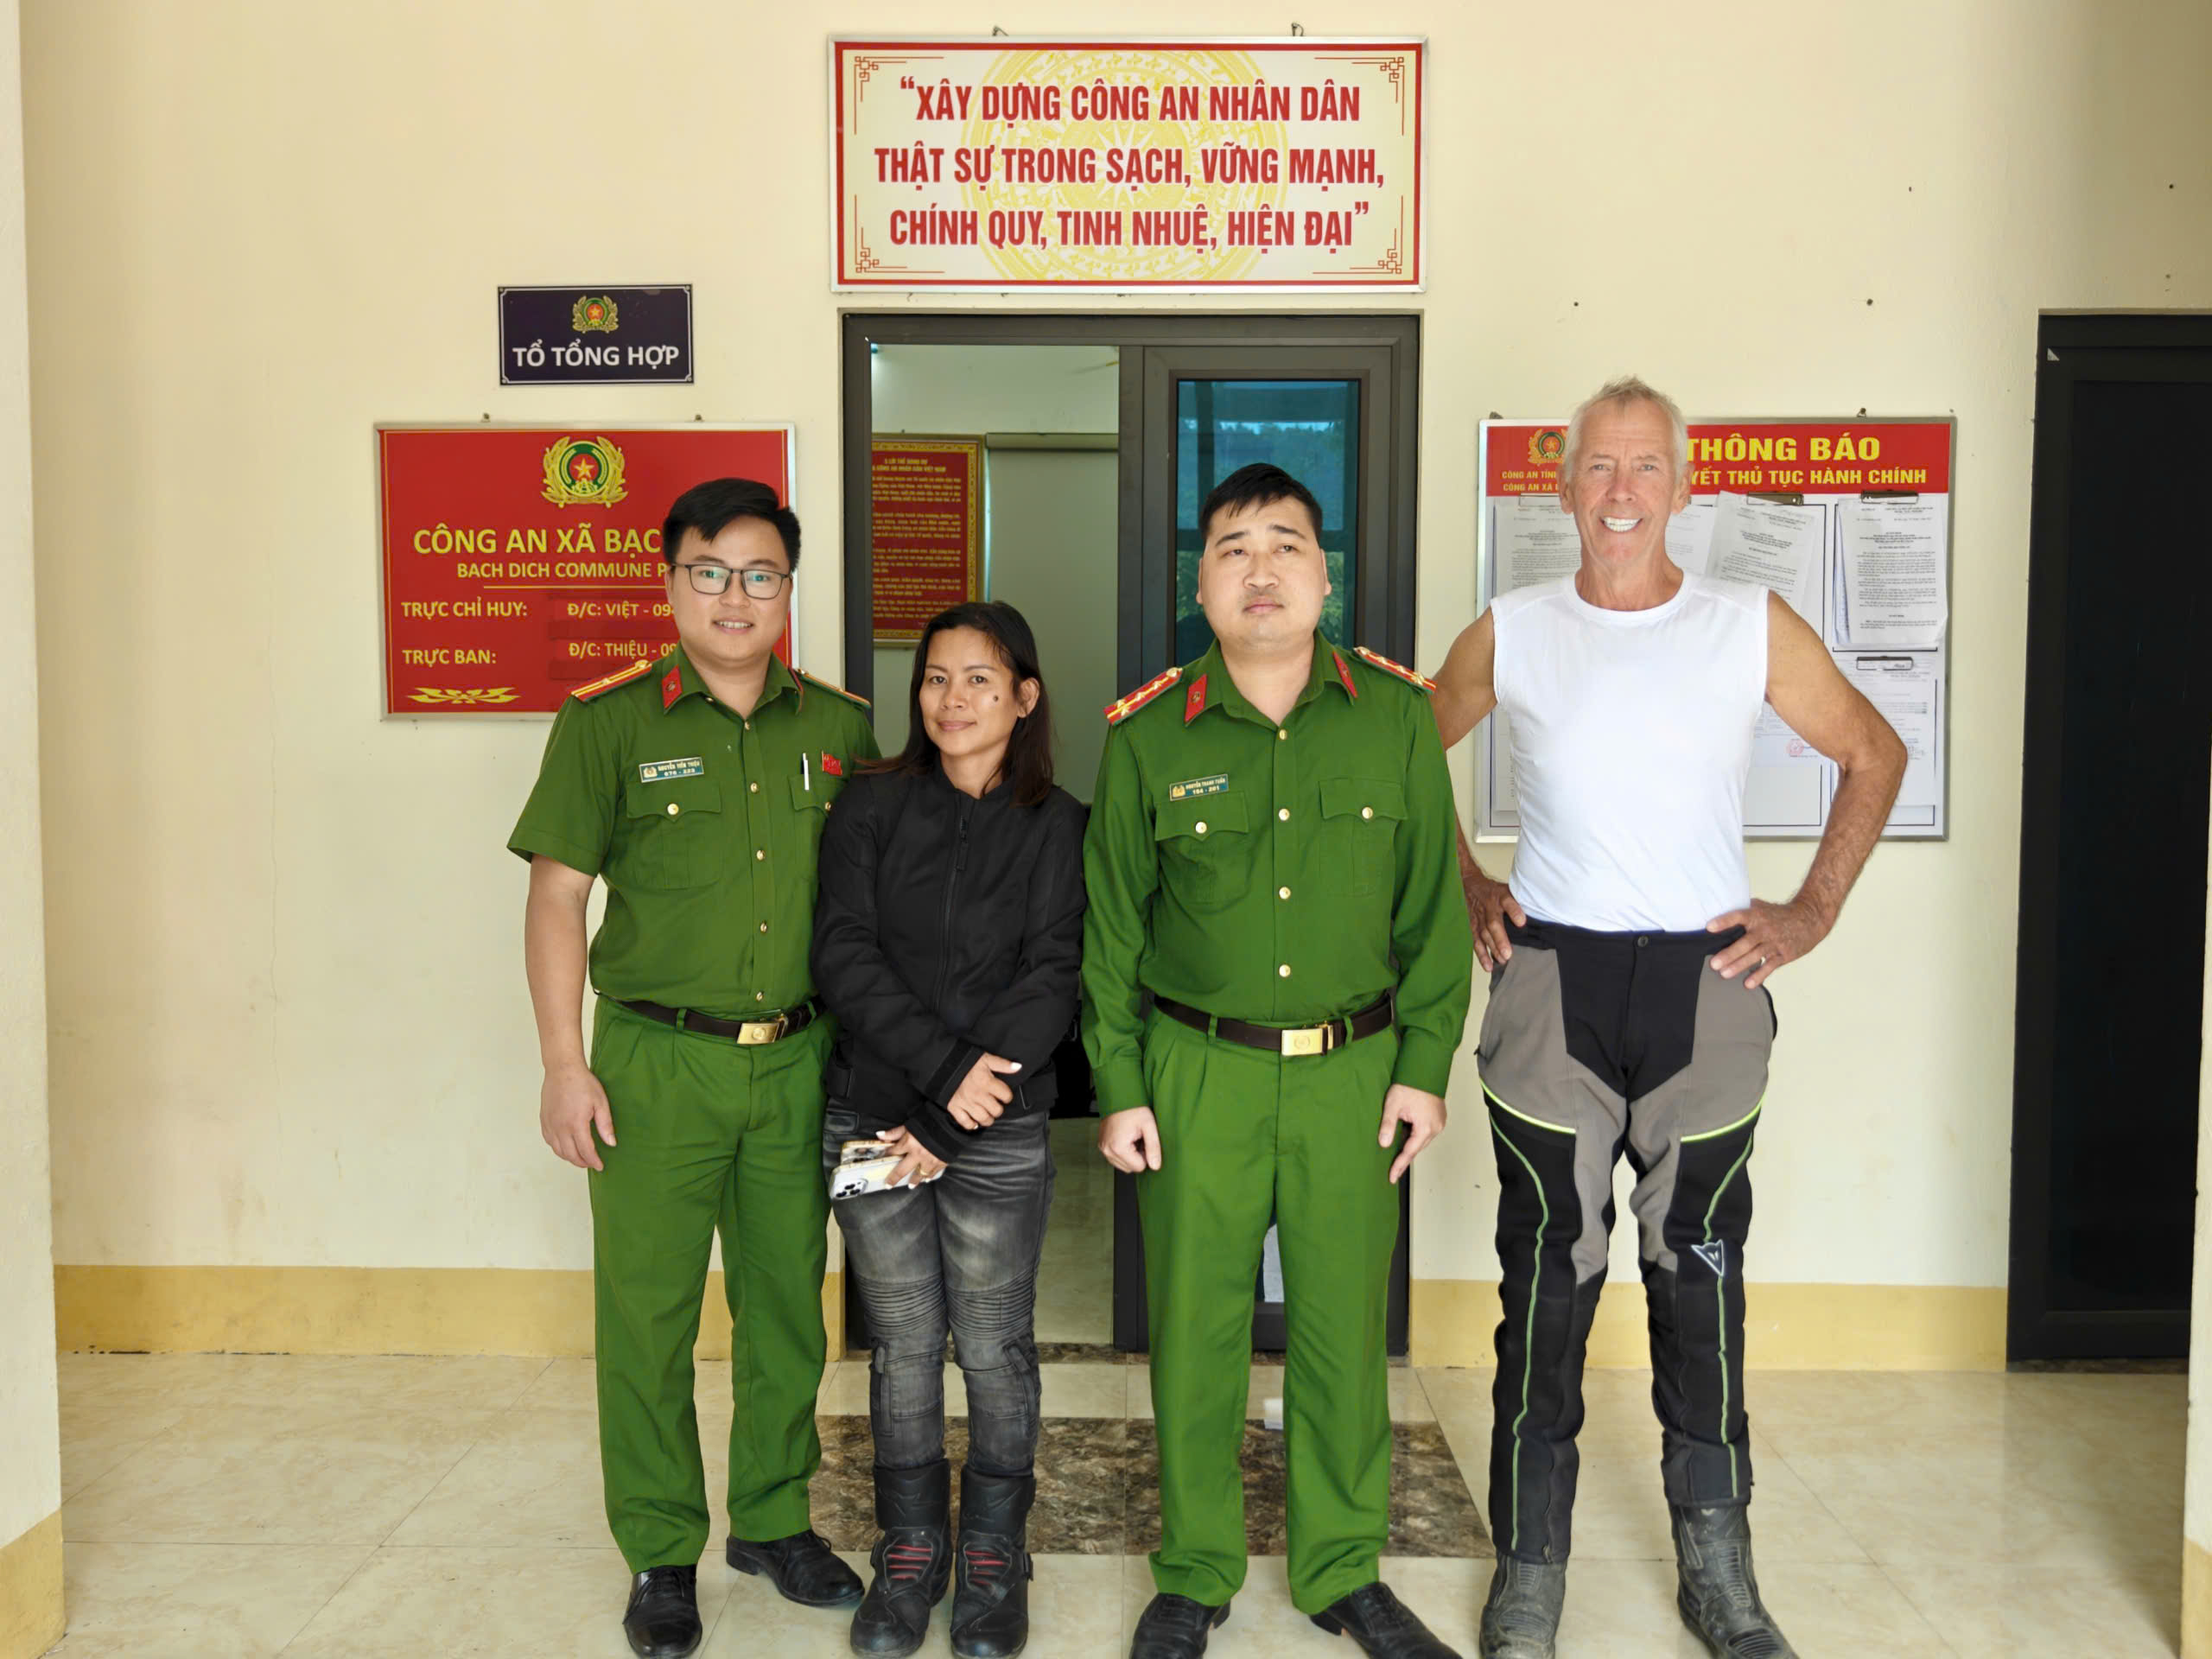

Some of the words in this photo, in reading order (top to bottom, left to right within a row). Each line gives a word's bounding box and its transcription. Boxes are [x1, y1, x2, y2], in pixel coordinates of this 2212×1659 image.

[899, 76, 972, 121] “XÂY
[982, 81, 1061, 129] DỰNG
[1071, 78, 1149, 121] CÔNG
[1159, 86, 1199, 121] AN
[1209, 79, 1290, 121] NHÂN
[1300, 79, 1360, 122] DÂN
[874, 140, 945, 191] THẬT
[954, 143, 995, 191] SỰ
[1001, 148, 1096, 183] TRONG
[1106, 148, 1192, 192] SẠCH,
[1201, 140, 1278, 184] VỮNG
[1289, 149, 1384, 192] MẠNH,
[890, 202, 978, 245] CHÍNH
[988, 210, 1047, 250] QUY,
[1057, 210, 1122, 245] TINH
[1132, 203, 1217, 254] NHUỆ,
[1228, 203, 1295, 254] HIỆN
[1304, 200, 1370, 254] ĐẠI”
[512, 338, 545, 367] TỔ
[550, 338, 620, 366] TỔNG
[627, 344, 679, 370] HỢP
[1687, 432, 1797, 461] THÔNG
[1809, 431, 1880, 461] BÁO
[1501, 469, 1525, 480] CÔNG
[1526, 471, 1539, 480] AN
[1691, 466, 1722, 485] YẾT
[1726, 465, 1763, 486] THỦ
[1768, 469, 1804, 488] TỤC
[1809, 467, 1862, 485] HÀNH
[1867, 466, 1927, 485] CHÍNH
[1503, 482, 1526, 492] CÔNG
[1527, 483, 1540, 492] AN
[414, 522, 497, 554] CÔNG
[505, 528, 547, 554] AN
[556, 522, 596, 554] XÃ
[604, 528, 661, 559] BẠC
[457, 563, 504, 578] BACH
[508, 563, 550, 578] DICH
[555, 562, 652, 578] COMMUNE
[400, 601, 449, 620] TRỰC
[452, 595, 482, 618] CHỈ
[486, 601, 528, 617] HUY:
[566, 601, 601, 619] Đ/C:
[605, 601, 639, 620] VIỆT
[652, 603, 674, 616] 09
[402, 649, 450, 669] TRỰC
[455, 649, 497, 664] BAN:
[568, 642, 601, 659] Đ/C:
[604, 640, 648, 659] THIỆU
